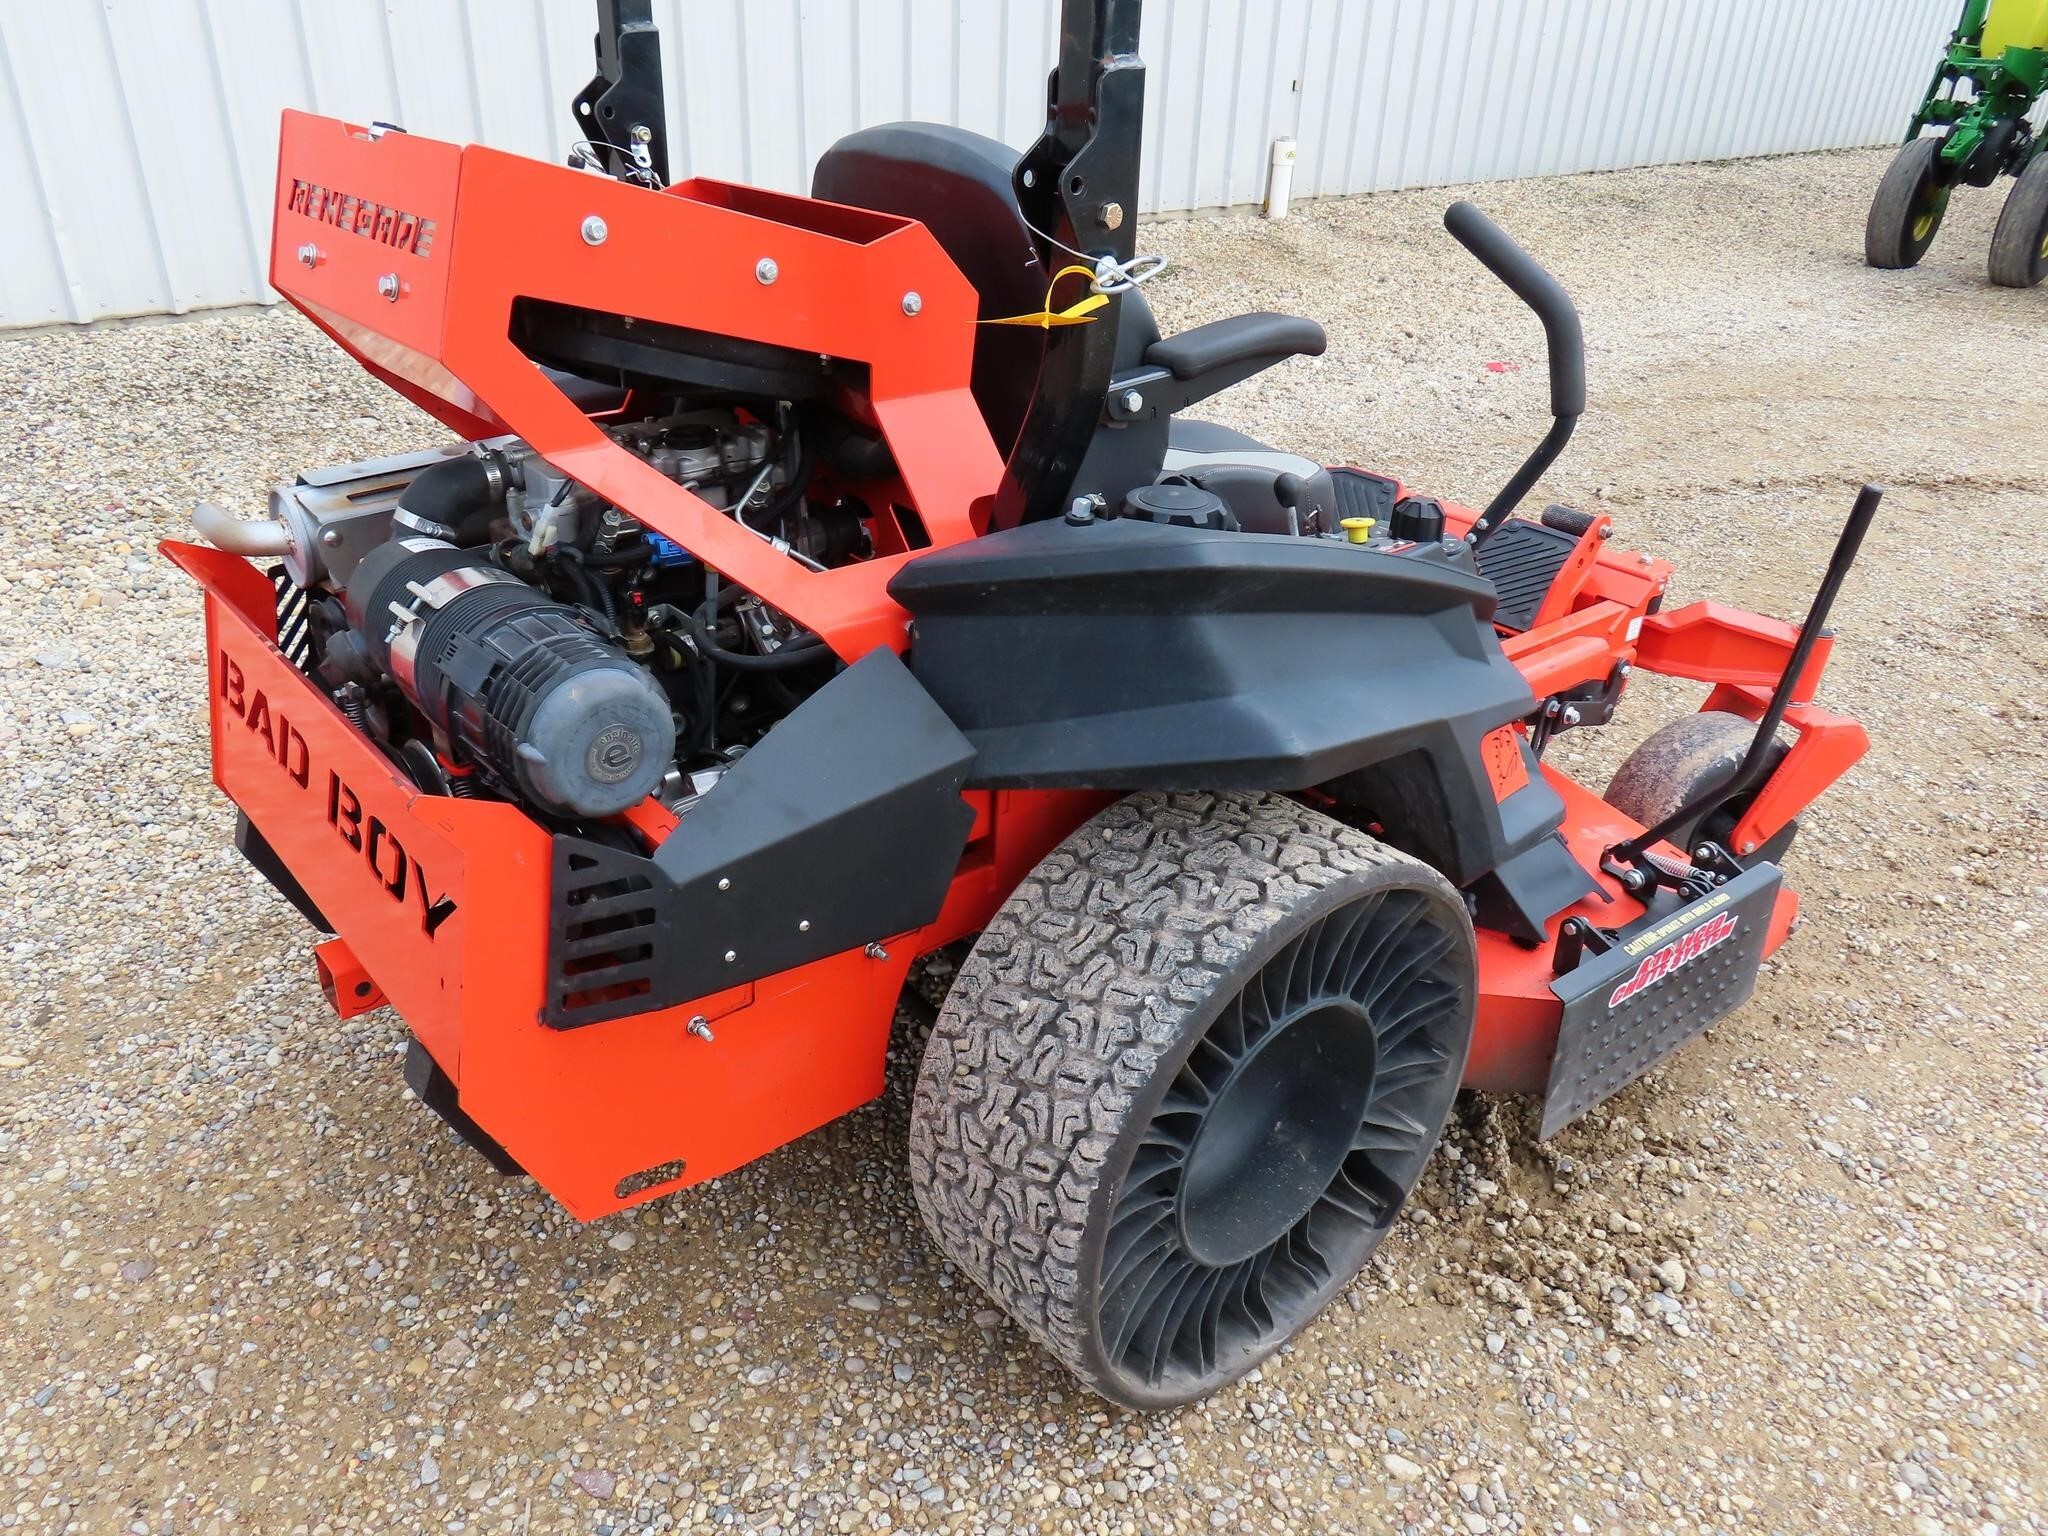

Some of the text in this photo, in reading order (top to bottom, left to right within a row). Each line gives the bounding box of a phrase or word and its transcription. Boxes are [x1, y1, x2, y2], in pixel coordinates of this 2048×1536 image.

[288, 178, 437, 258] RENEGADE
[220, 649, 458, 943] BAD BOY
[1610, 917, 1737, 1007] CHUTE SYSTEM
